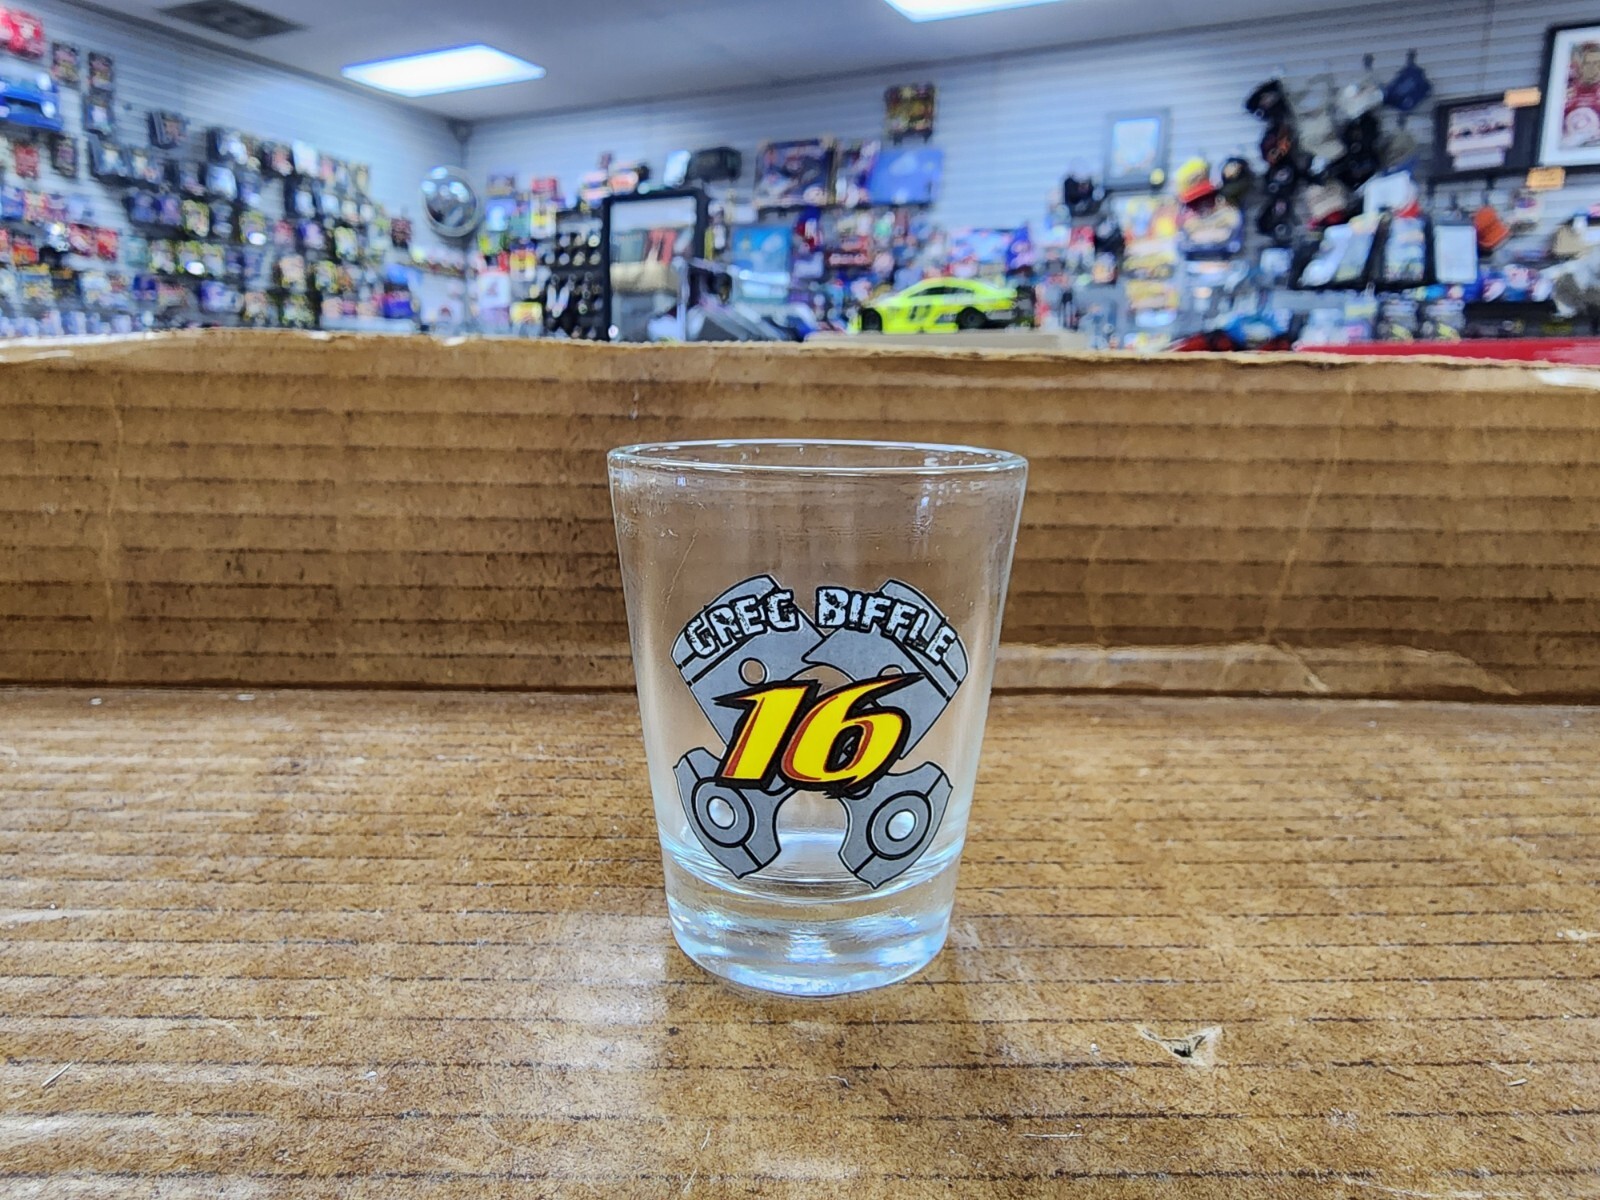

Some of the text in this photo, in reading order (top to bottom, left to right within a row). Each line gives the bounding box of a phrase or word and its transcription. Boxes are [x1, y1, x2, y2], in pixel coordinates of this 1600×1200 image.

[687, 587, 958, 663] GREG BIFFLE
[713, 674, 925, 797] 16
